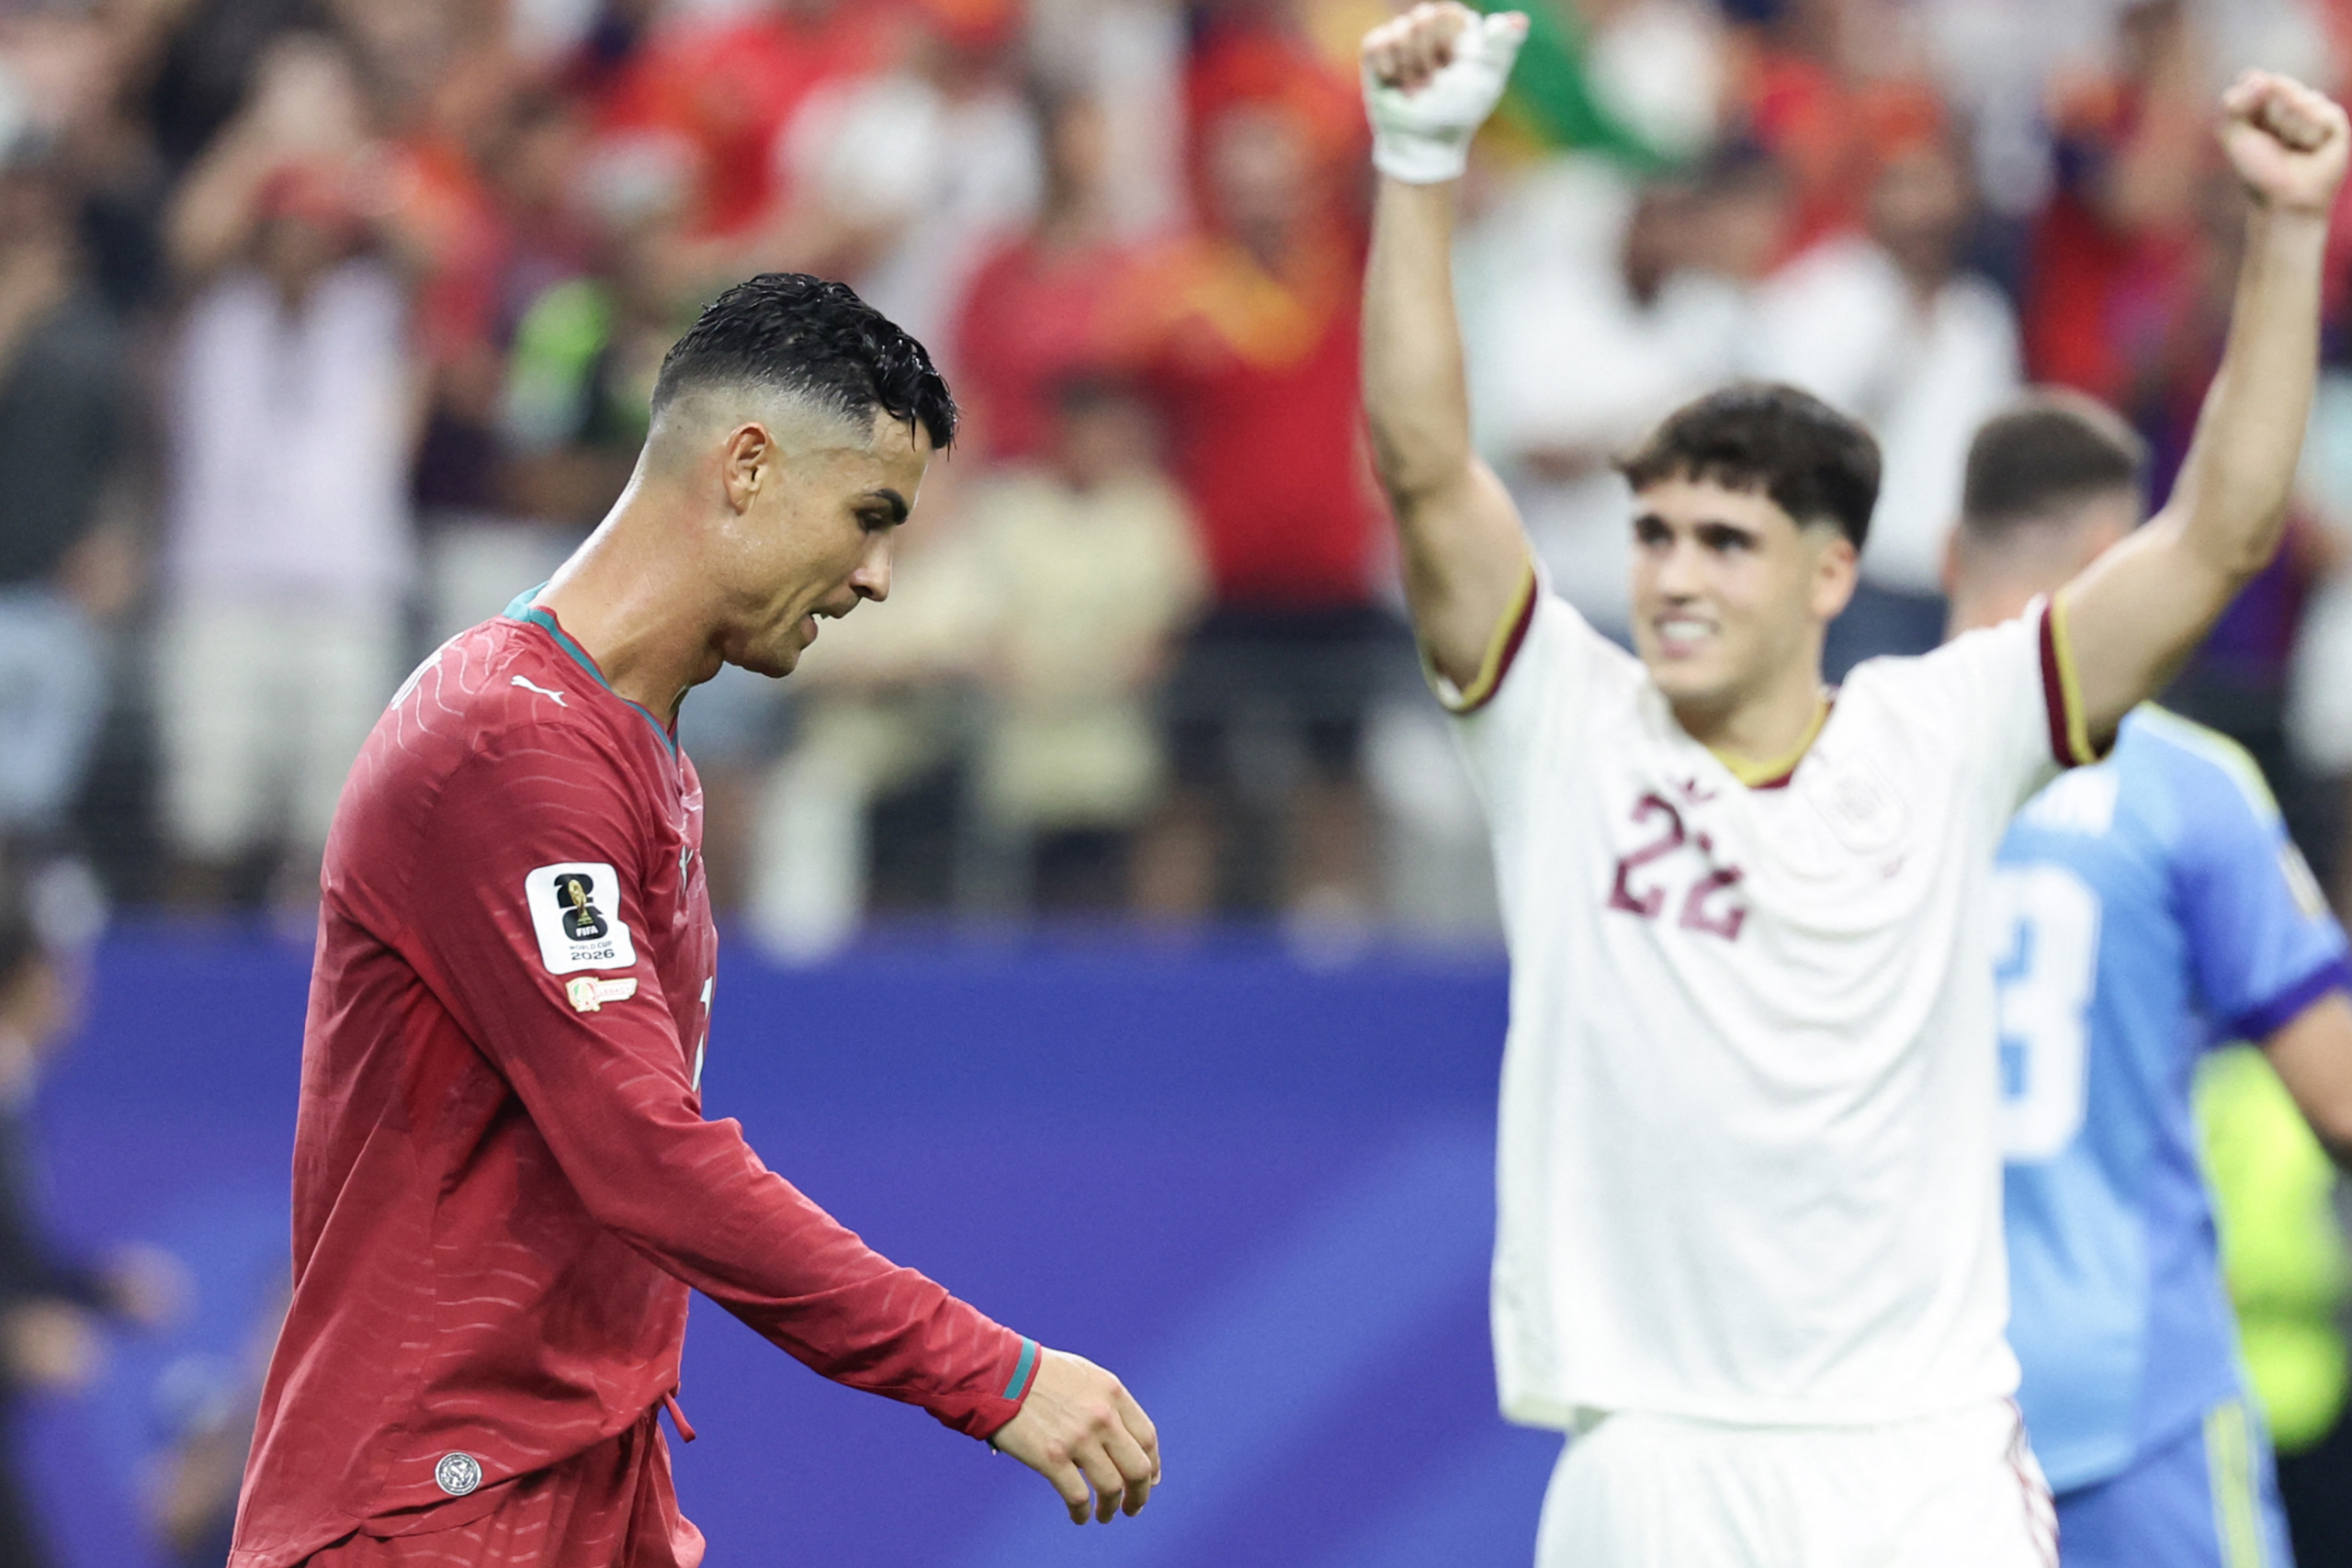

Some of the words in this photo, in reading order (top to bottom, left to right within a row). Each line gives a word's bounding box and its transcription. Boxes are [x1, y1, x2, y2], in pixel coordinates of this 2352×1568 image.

[1609, 792, 1747, 942] 22
[576, 925, 598, 937] FIFA
[571, 949, 615, 961] 2026
